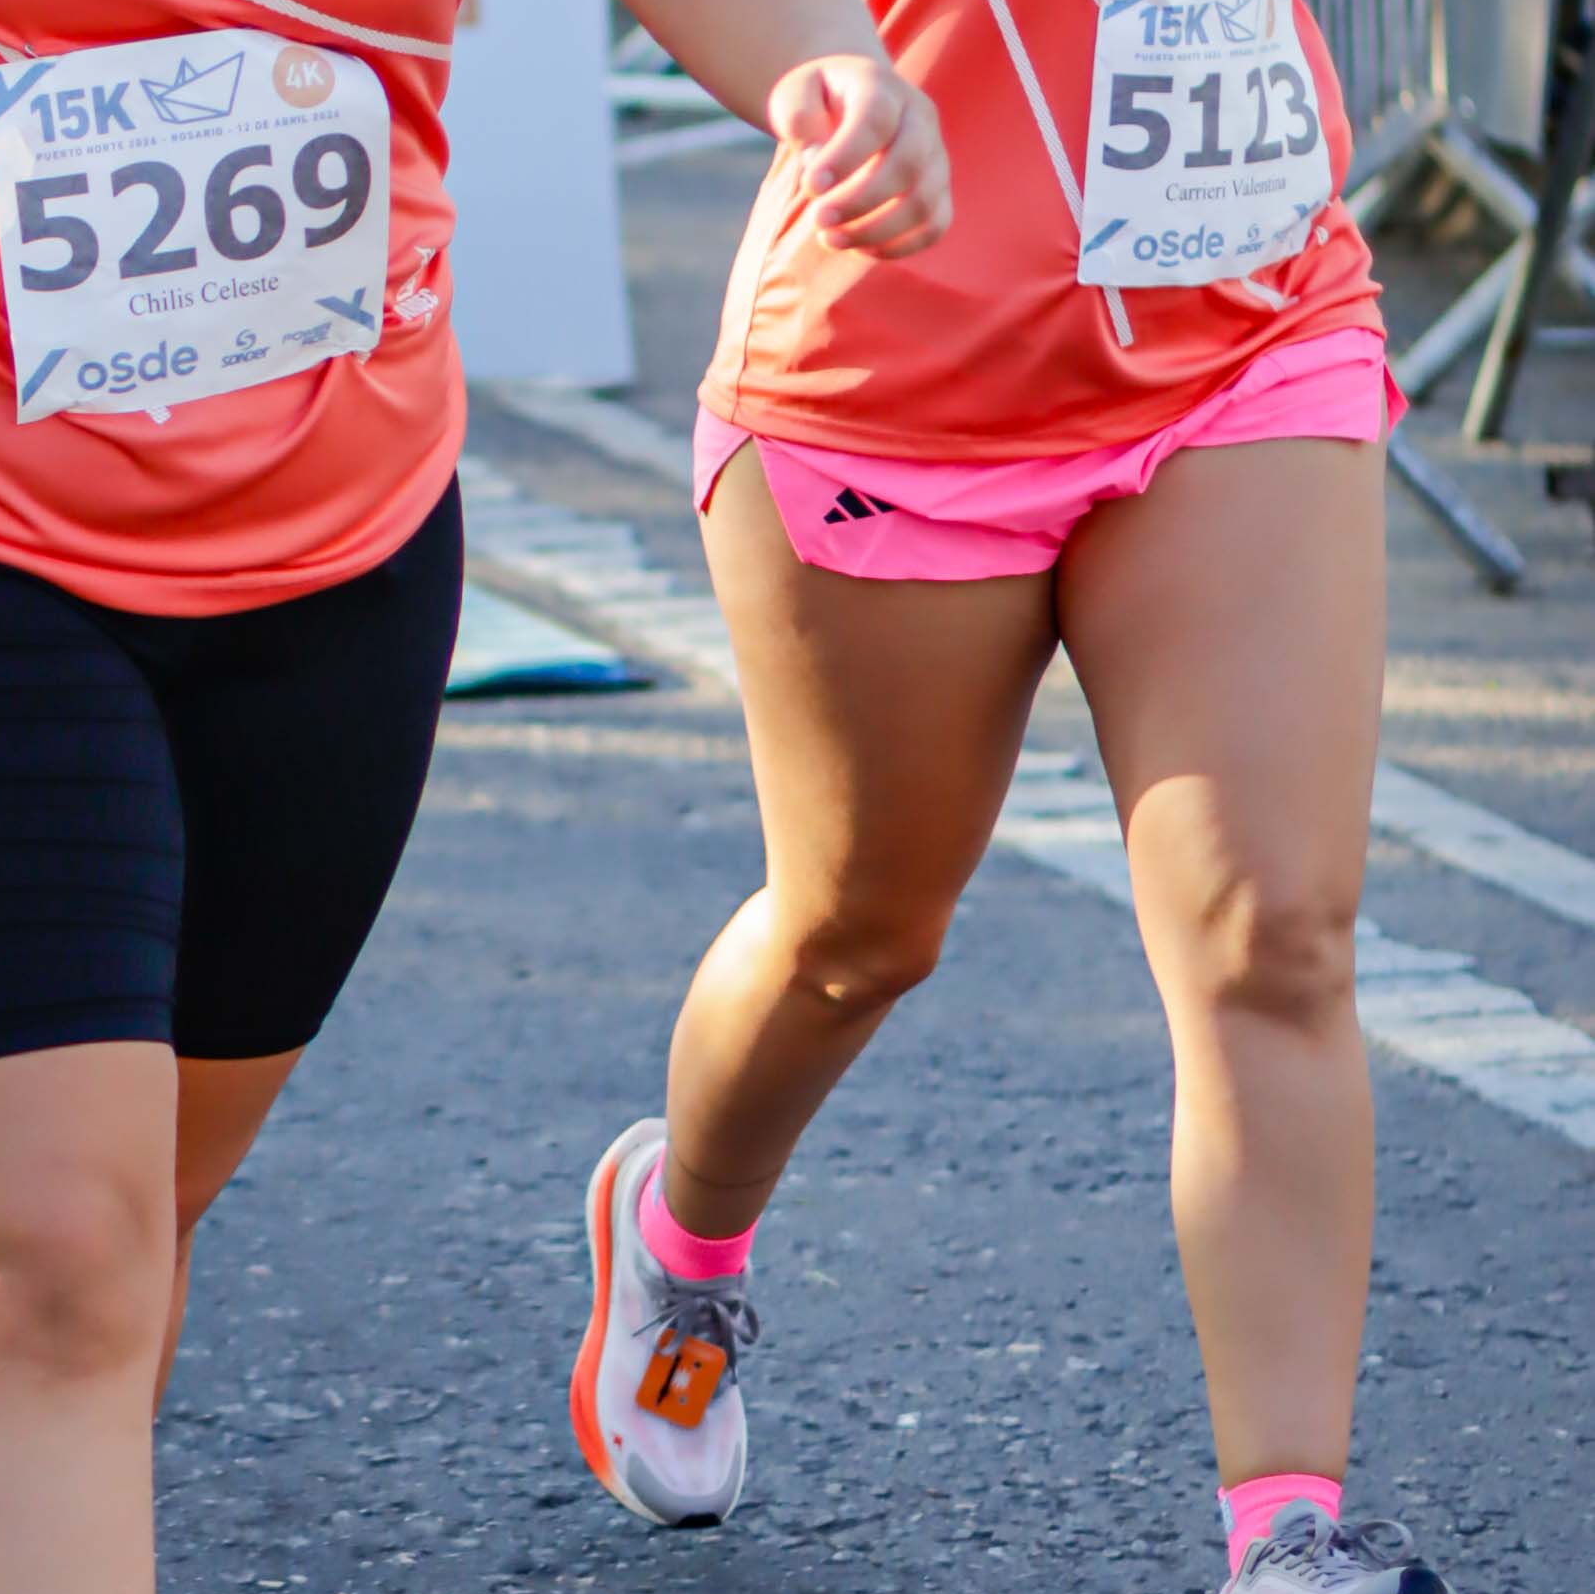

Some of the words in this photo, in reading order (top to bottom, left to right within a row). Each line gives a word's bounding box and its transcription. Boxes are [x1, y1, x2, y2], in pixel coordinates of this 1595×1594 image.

[1139, 4, 1209, 47] 15K
[285, 60, 324, 89] 4K
[29, 81, 136, 144] 15K
[15, 132, 373, 293] 5269
[1132, 223, 1225, 268] osde
[128, 288, 195, 317] Chilis
[200, 276, 280, 304] Celeste
[77, 341, 199, 394] osde
